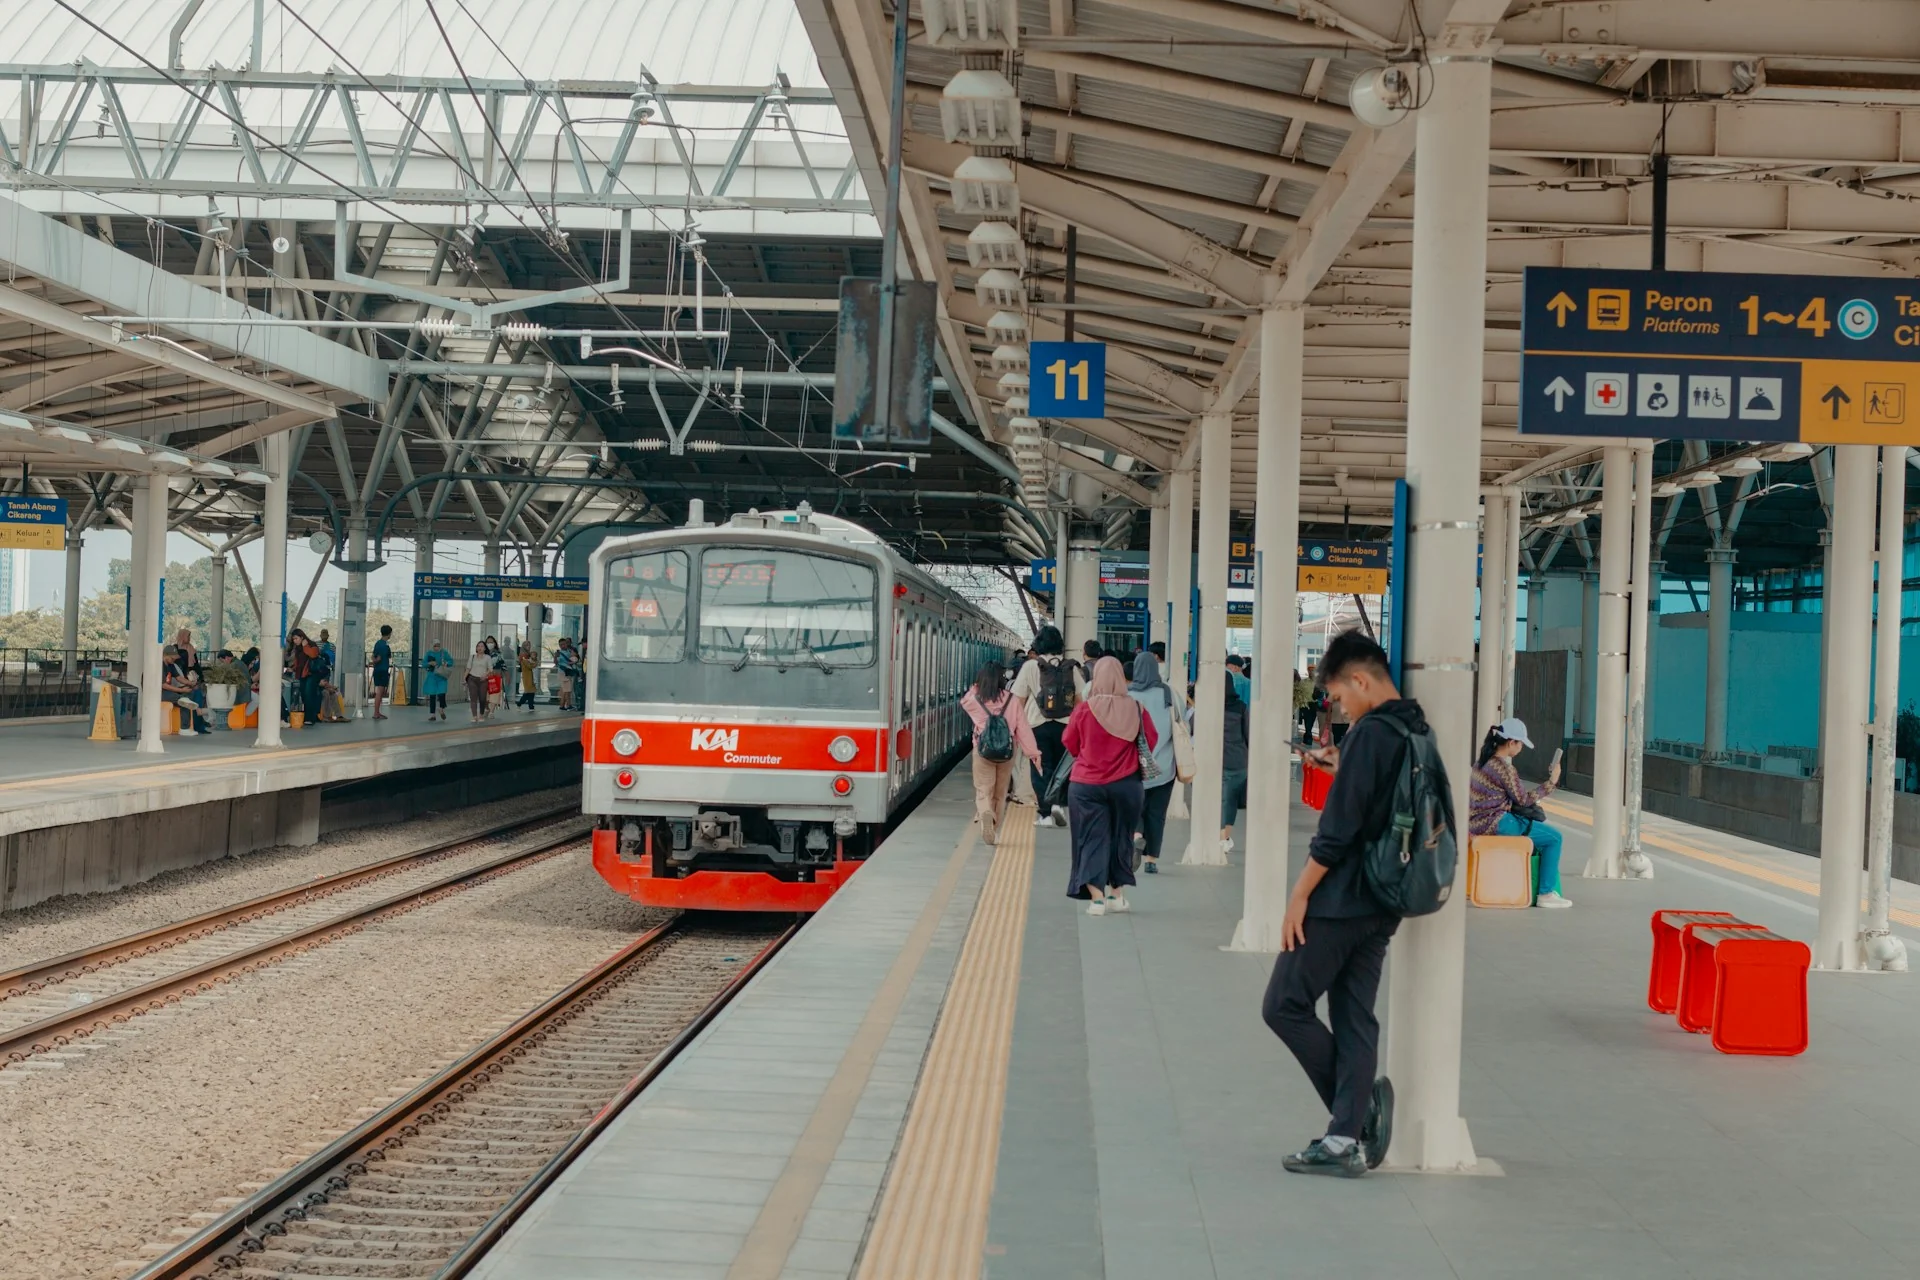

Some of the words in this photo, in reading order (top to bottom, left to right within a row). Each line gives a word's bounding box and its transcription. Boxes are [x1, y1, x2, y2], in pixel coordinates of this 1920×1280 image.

[1645, 290, 1713, 313] Peron
[1738, 295, 1832, 338] 1~4
[1851, 311, 1865, 326] C
[1642, 317, 1720, 335] Platforms
[1046, 359, 1089, 401] 11
[8, 502, 30, 510] Tanah
[32, 502, 56, 512] Abang
[8, 510, 42, 520] Cikarang
[1328, 545, 1352, 554] Tanah
[1352, 547, 1378, 557] Abang
[1328, 555, 1363, 566] Cikarang
[1038, 566, 1057, 584] 11
[1337, 573, 1361, 581] Keluar
[635, 603, 653, 614] 44
[690, 728, 740, 751] KAI
[723, 751, 782, 765] Commuter
